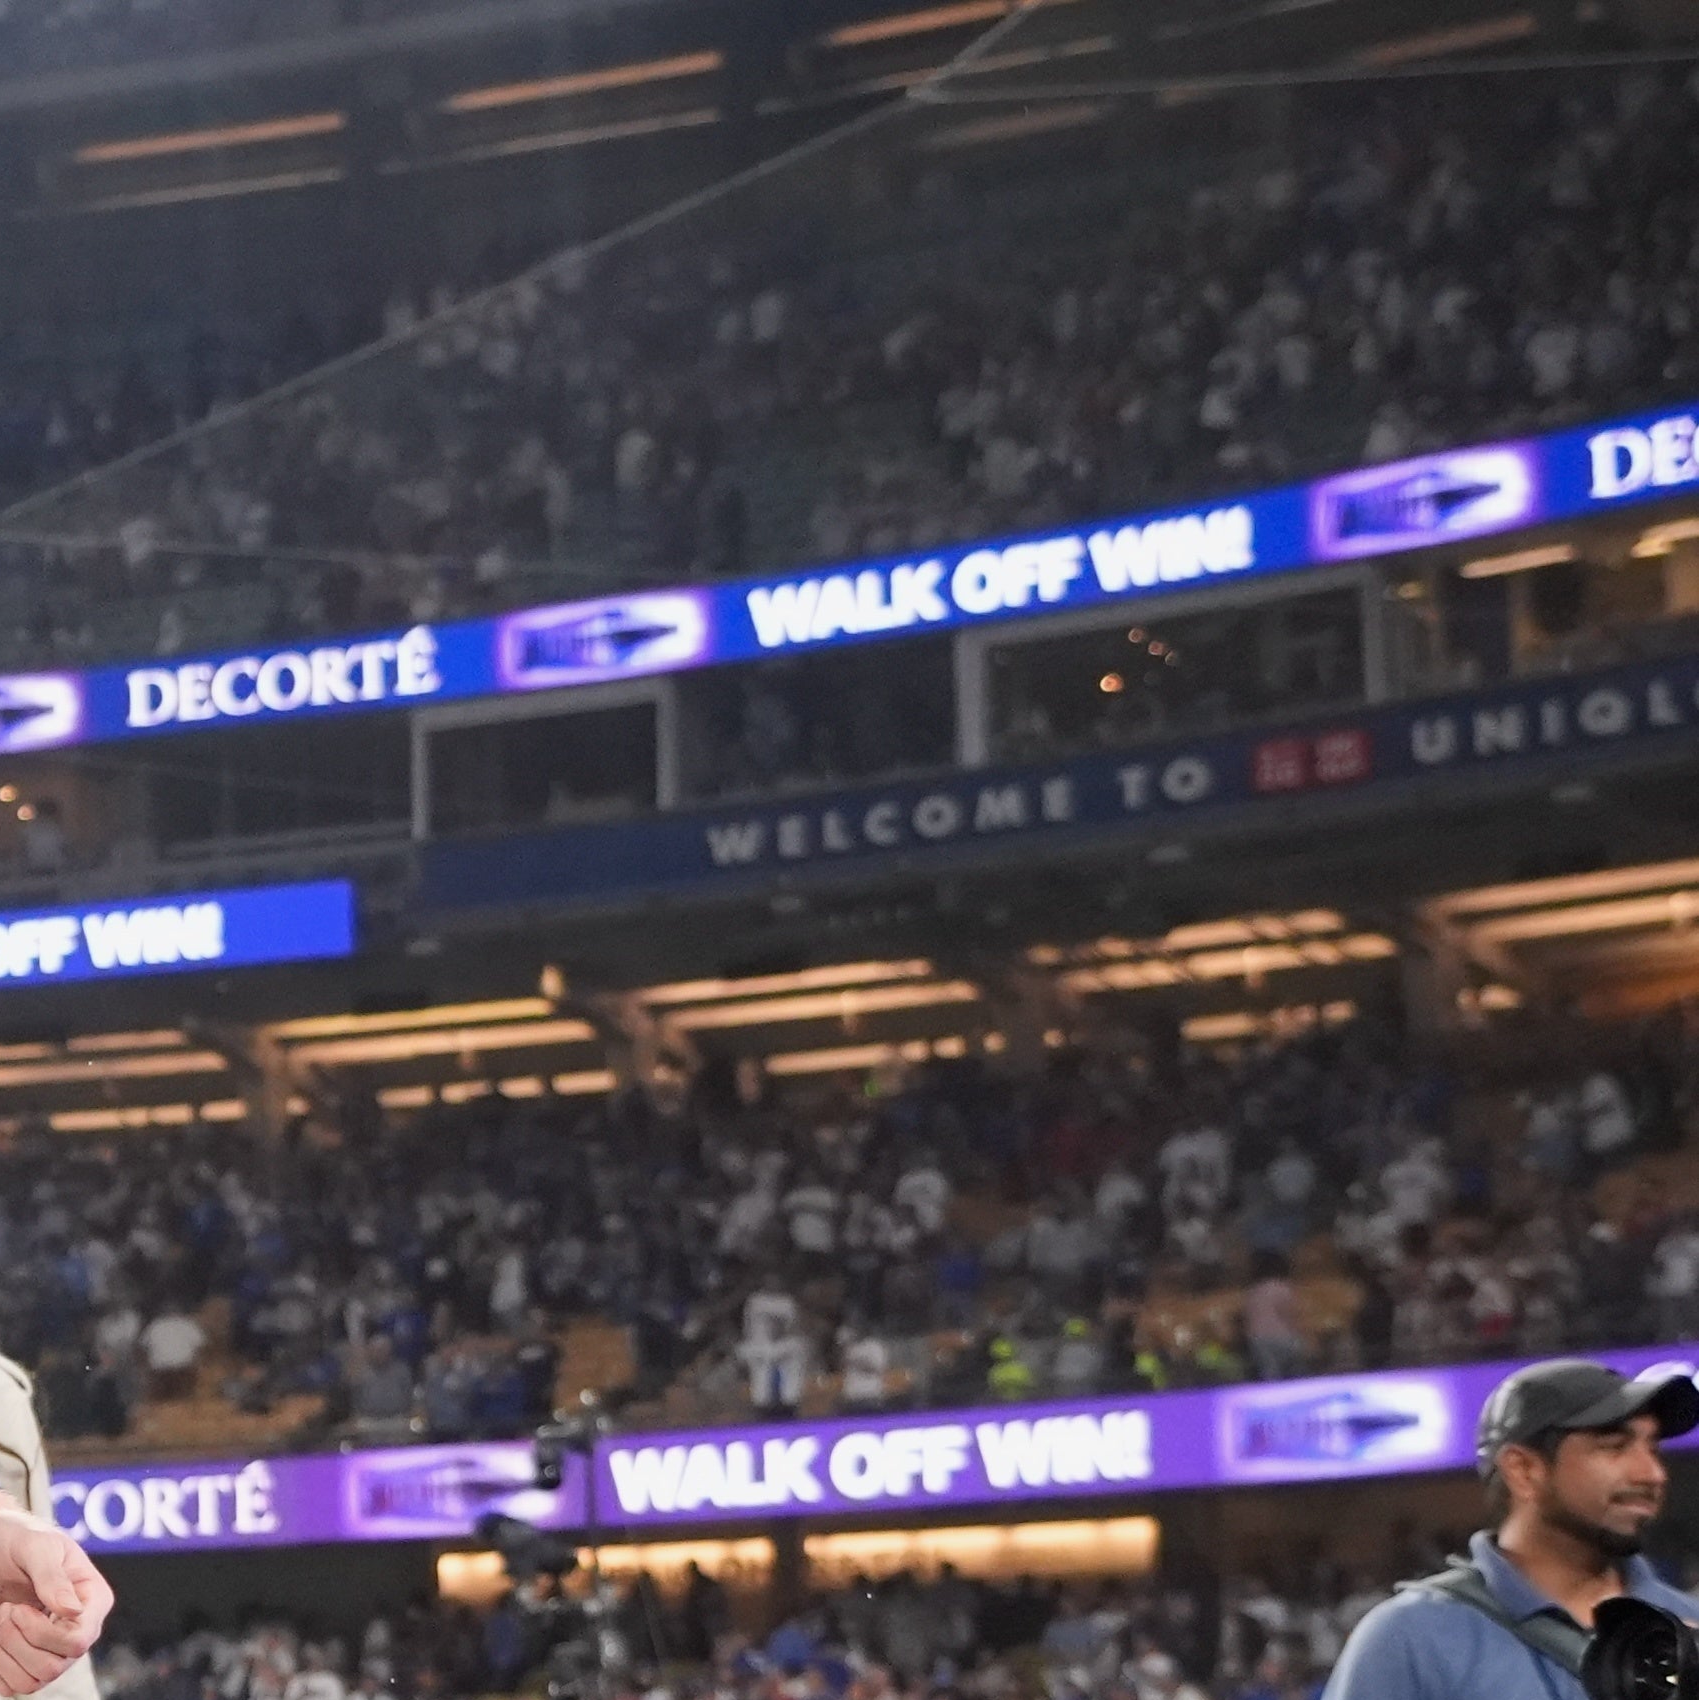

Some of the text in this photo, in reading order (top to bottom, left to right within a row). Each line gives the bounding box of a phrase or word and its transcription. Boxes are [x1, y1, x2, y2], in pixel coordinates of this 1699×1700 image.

[1586, 415, 1699, 498] DE
[747, 506, 1254, 648] WALK OFF WIN!
[127, 624, 441, 727] DECORTÉ
[707, 777, 1078, 864] WELCOME
[1117, 758, 1213, 808] TO
[82, 901, 225, 969] WIN!
[609, 1410, 1151, 1514] WALK OFF WIN!
